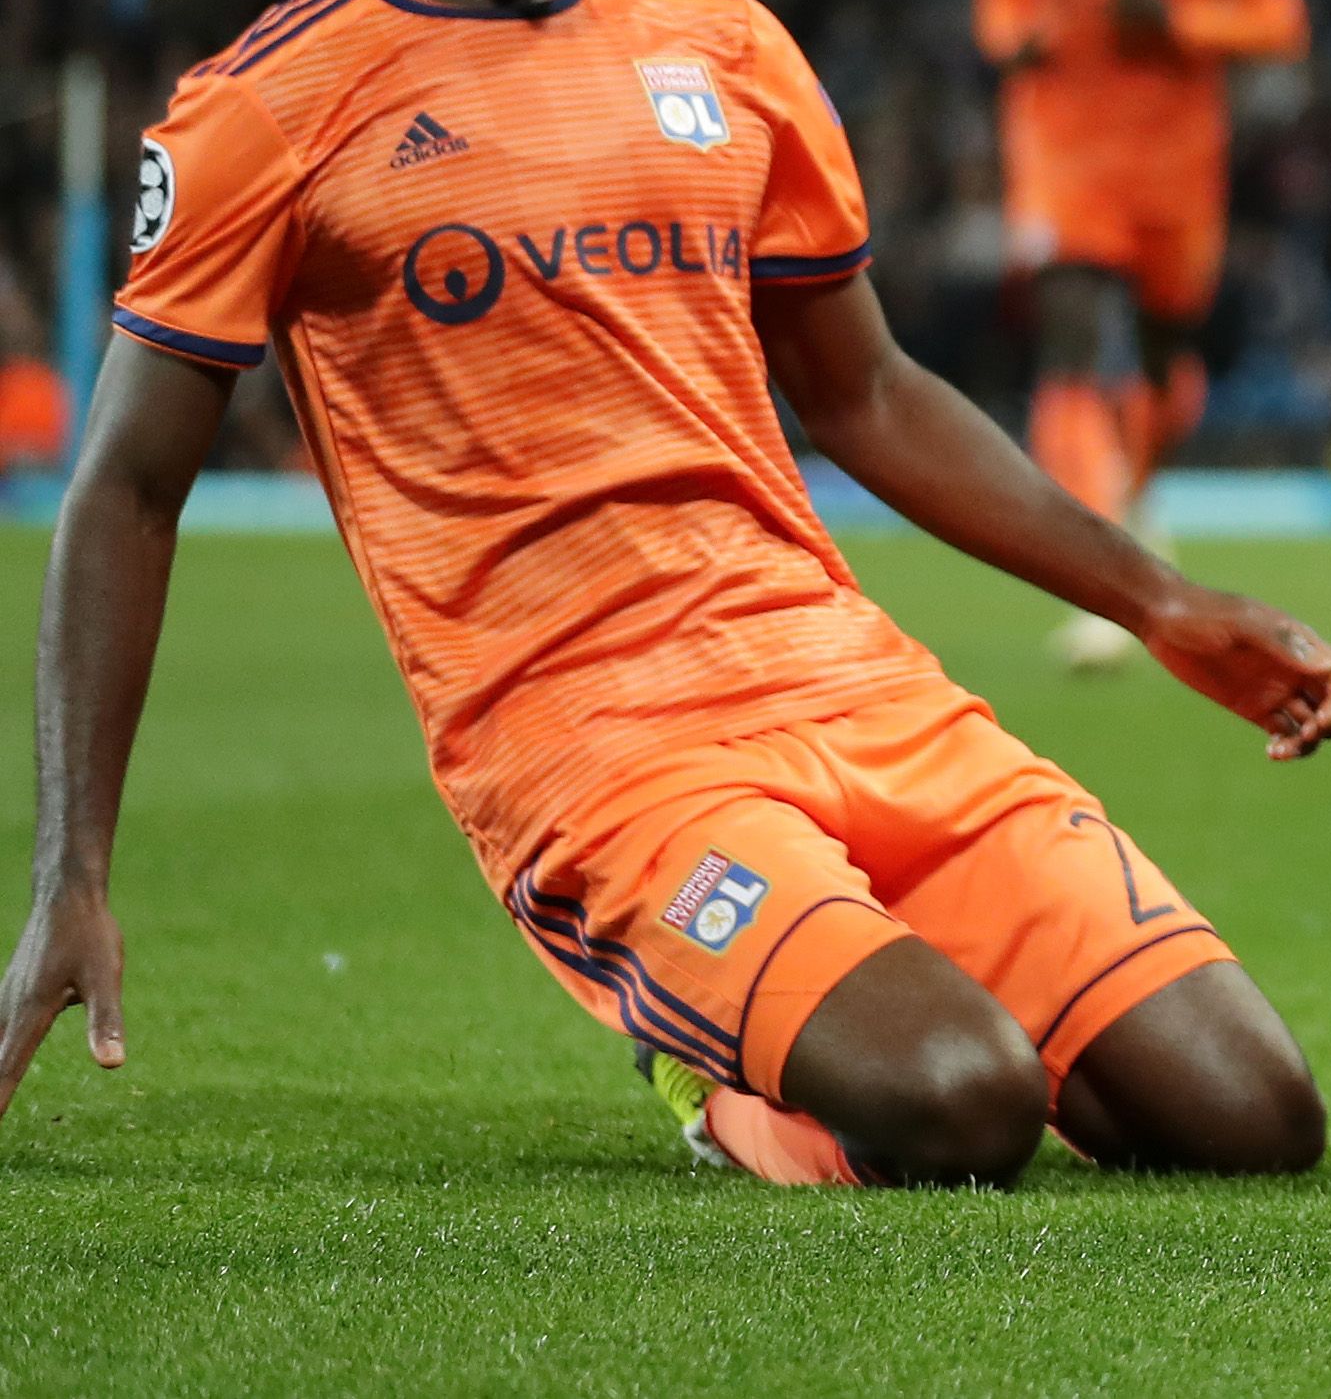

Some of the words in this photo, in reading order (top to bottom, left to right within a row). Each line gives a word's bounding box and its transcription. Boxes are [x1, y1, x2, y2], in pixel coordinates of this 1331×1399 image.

[390, 136, 469, 169] adidas
[516, 220, 741, 281] VEOLIA
[1070, 812, 1177, 925] 2
